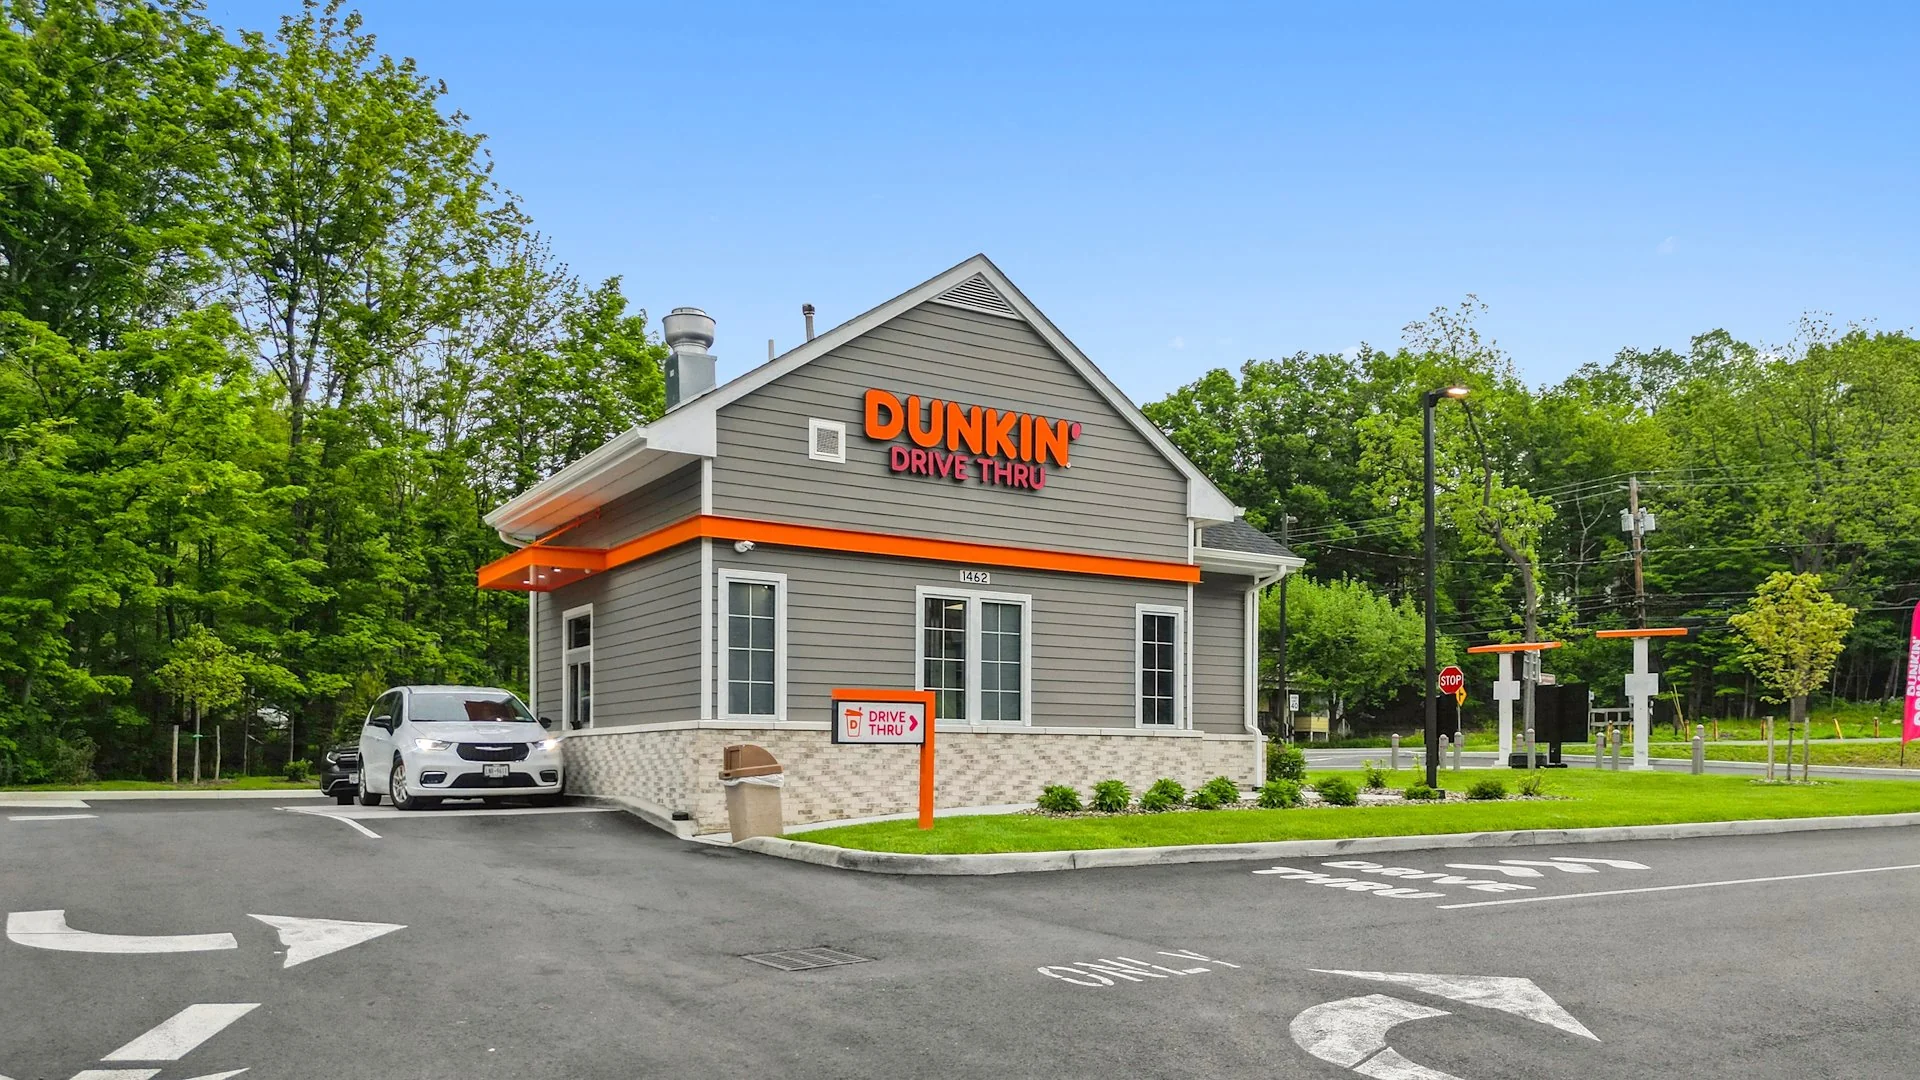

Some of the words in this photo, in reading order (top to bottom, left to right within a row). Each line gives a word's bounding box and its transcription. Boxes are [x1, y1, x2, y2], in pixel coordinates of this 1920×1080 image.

[865, 388, 1082, 467] DUNKIN'
[890, 445, 969, 481] DRIVE
[976, 458, 1046, 490] THRU
[962, 571, 988, 583] 1462
[1441, 675, 1461, 686] STOP
[869, 711, 906, 722] DRIVE
[869, 724, 903, 736] THRU
[1252, 866, 1446, 898] THRU
[1321, 861, 1537, 892] DRIVE
[1037, 949, 1241, 986] ONLY
